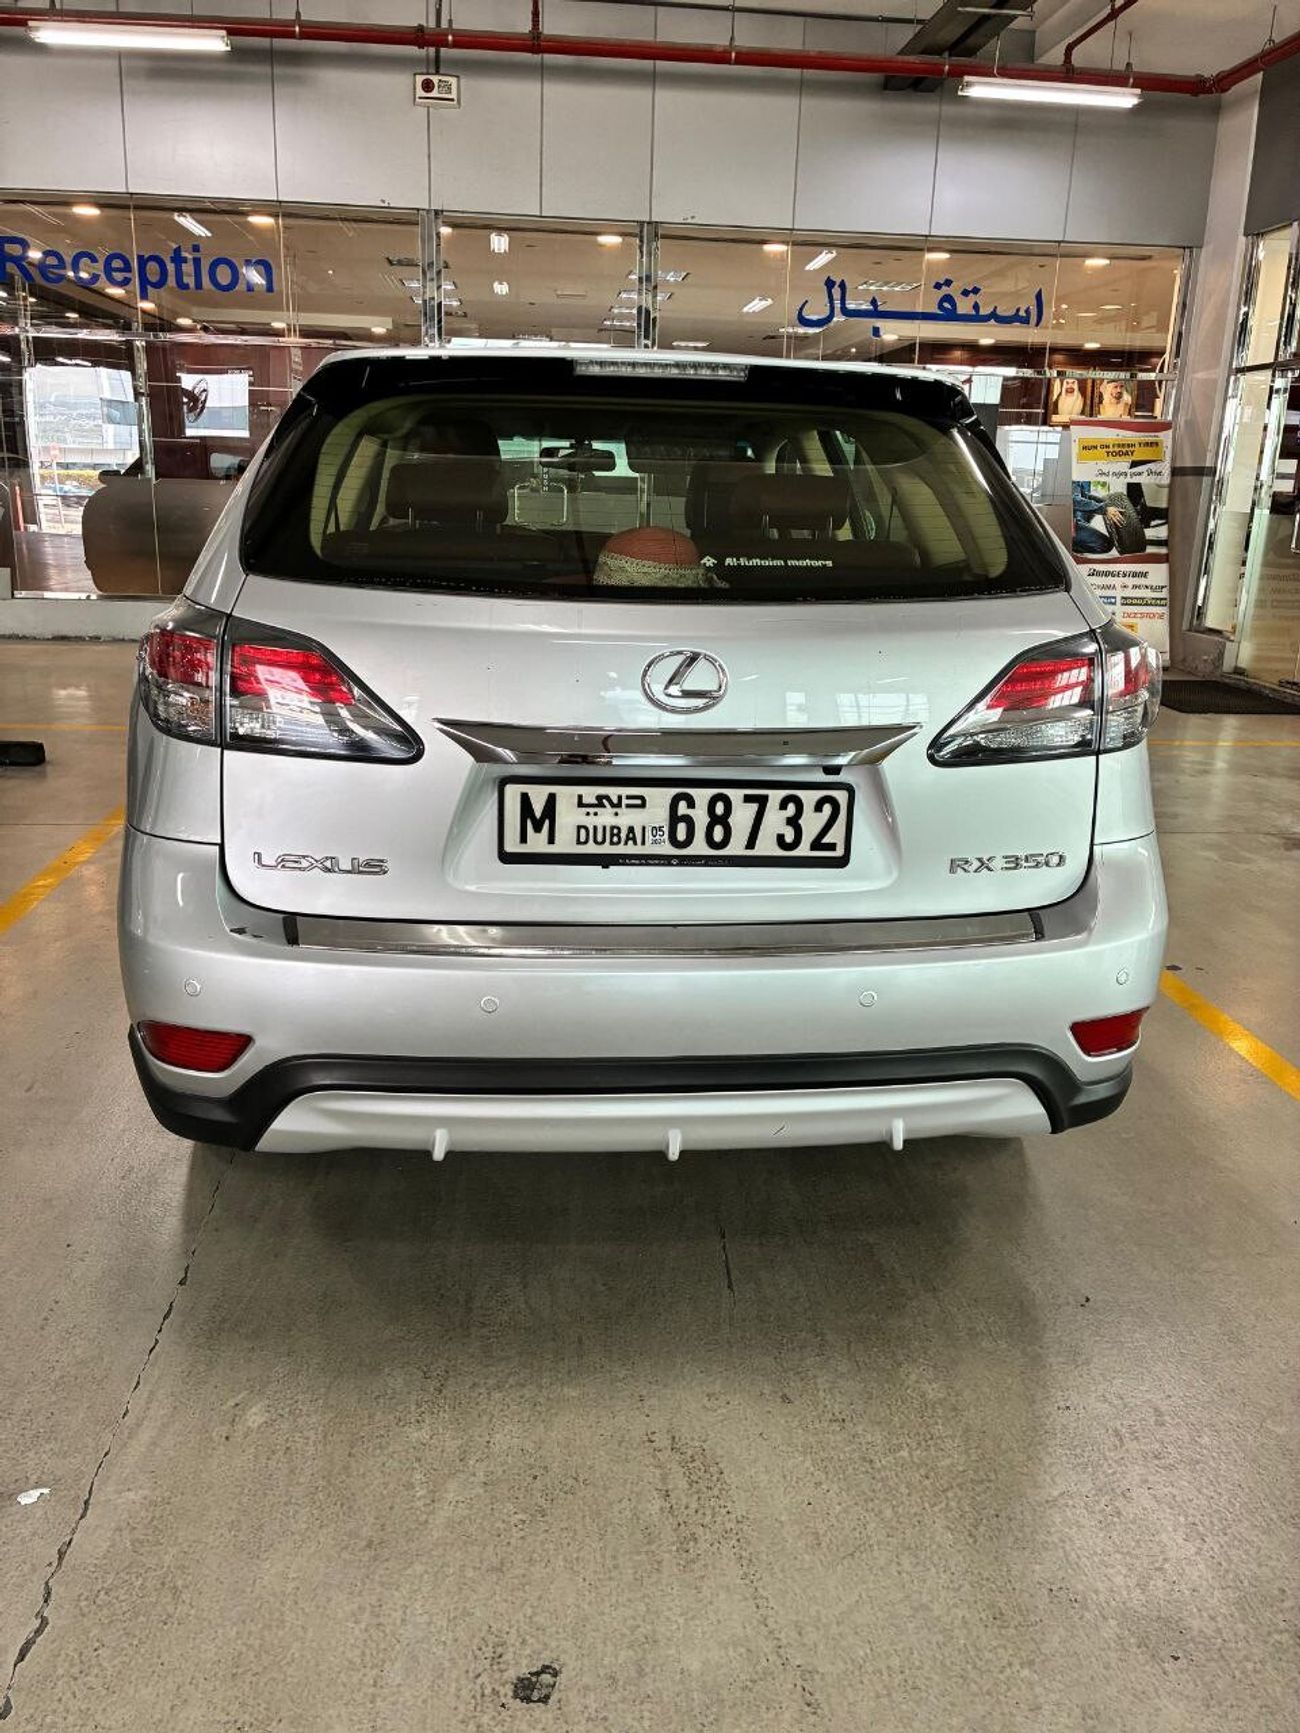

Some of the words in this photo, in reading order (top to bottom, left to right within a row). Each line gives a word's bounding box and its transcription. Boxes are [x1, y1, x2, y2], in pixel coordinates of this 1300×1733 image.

[0, 236, 274, 300] Reception
[1105, 450, 1136, 458] TODAY
[1138, 441, 1159, 449] TIRES
[1087, 568, 1150, 579] BRIDGESTONE
[1131, 584, 1168, 592] DUNLOP
[1121, 597, 1168, 606] GOODYEAR
[577, 794, 647, 817] دبي
[519, 792, 556, 845] M
[668, 792, 841, 851] 68732
[575, 825, 646, 846] DUBAI
[651, 826, 665, 838] 05
[253, 851, 389, 875] LEXUS
[949, 856, 996, 874] RX
[1000, 851, 1067, 870] 350
